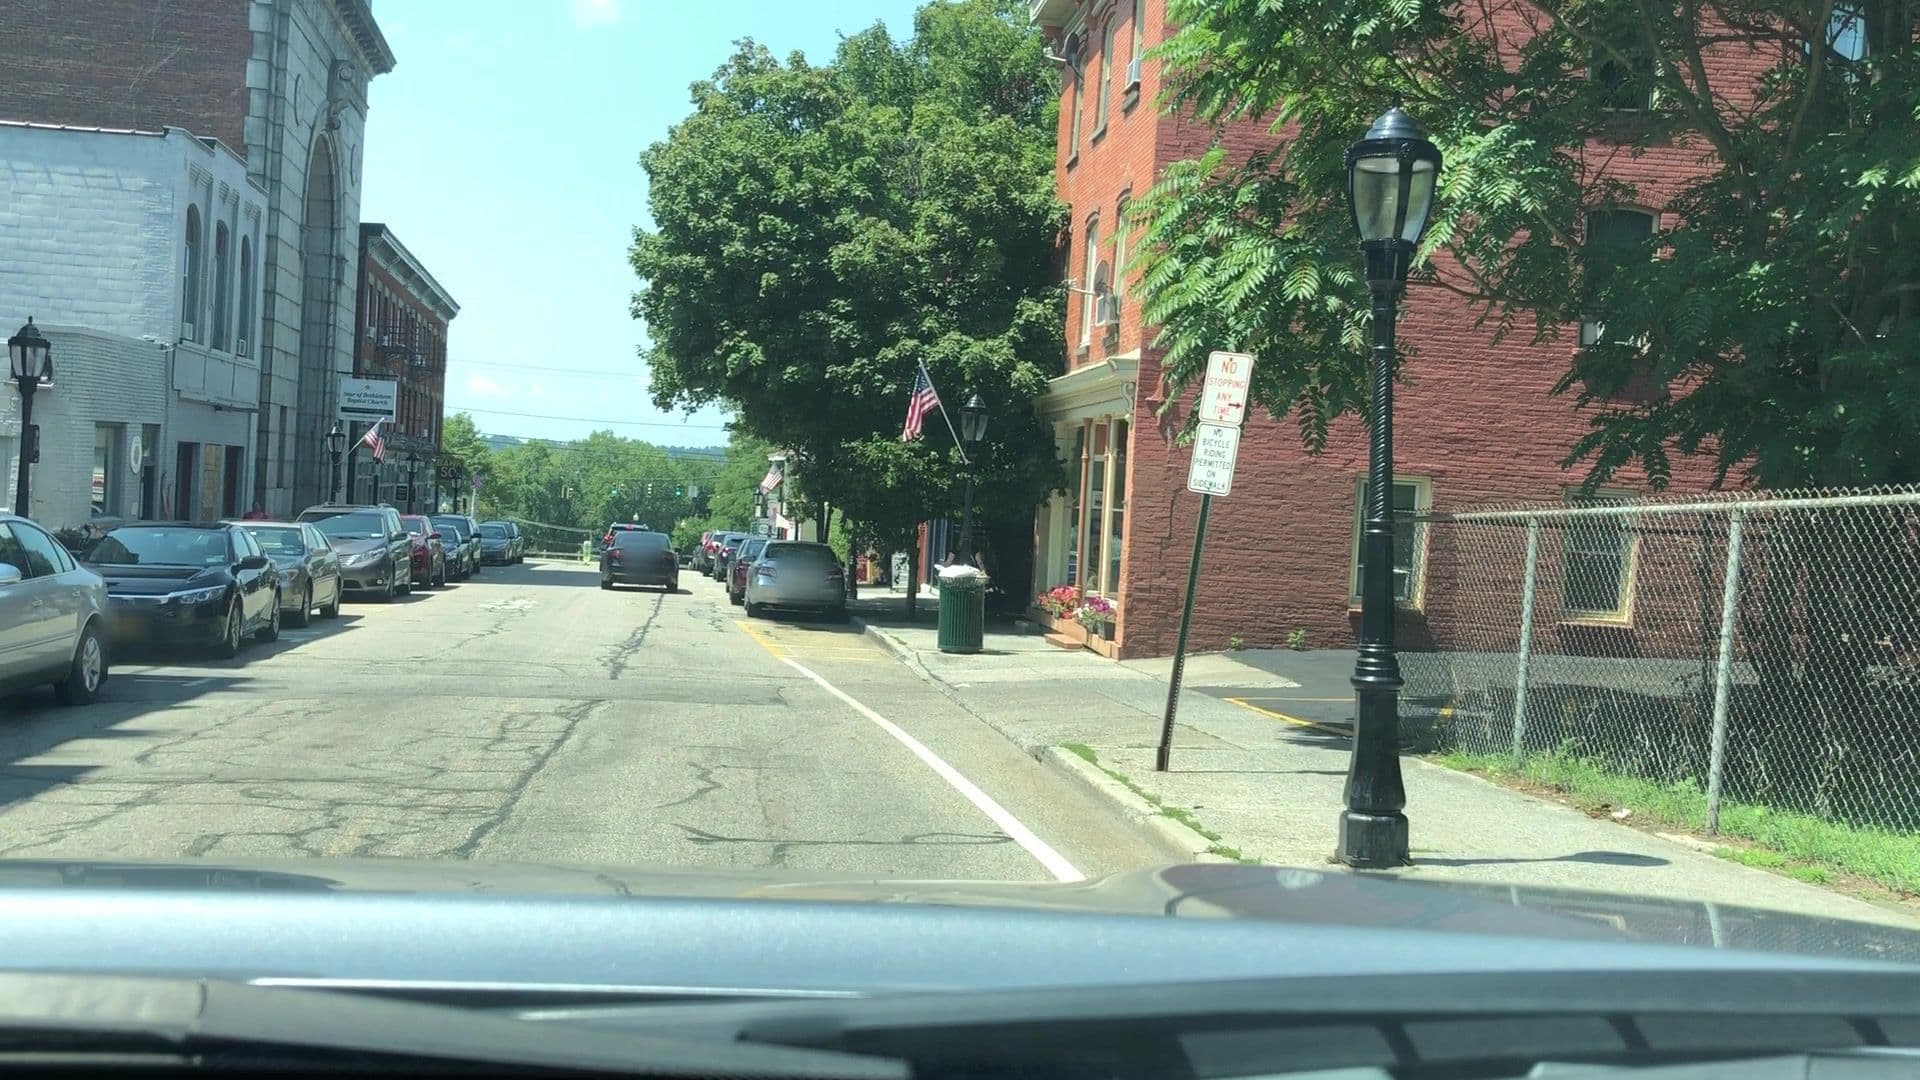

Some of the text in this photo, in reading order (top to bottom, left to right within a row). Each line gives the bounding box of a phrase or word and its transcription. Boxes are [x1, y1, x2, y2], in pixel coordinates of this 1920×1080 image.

[1221, 361, 1237, 374] NO
[1208, 377, 1246, 389] STOPPING
[1216, 391, 1232, 401] ANY
[1213, 404, 1231, 416] TIME
[1213, 428, 1224, 438] NO
[1202, 438, 1230, 448] BICYCLE
[1204, 448, 1226, 459] RIDING
[1196, 457, 1231, 469] PERMITTED
[1206, 469, 1217, 478] ON
[1193, 478, 1226, 490] SIDEWALK
